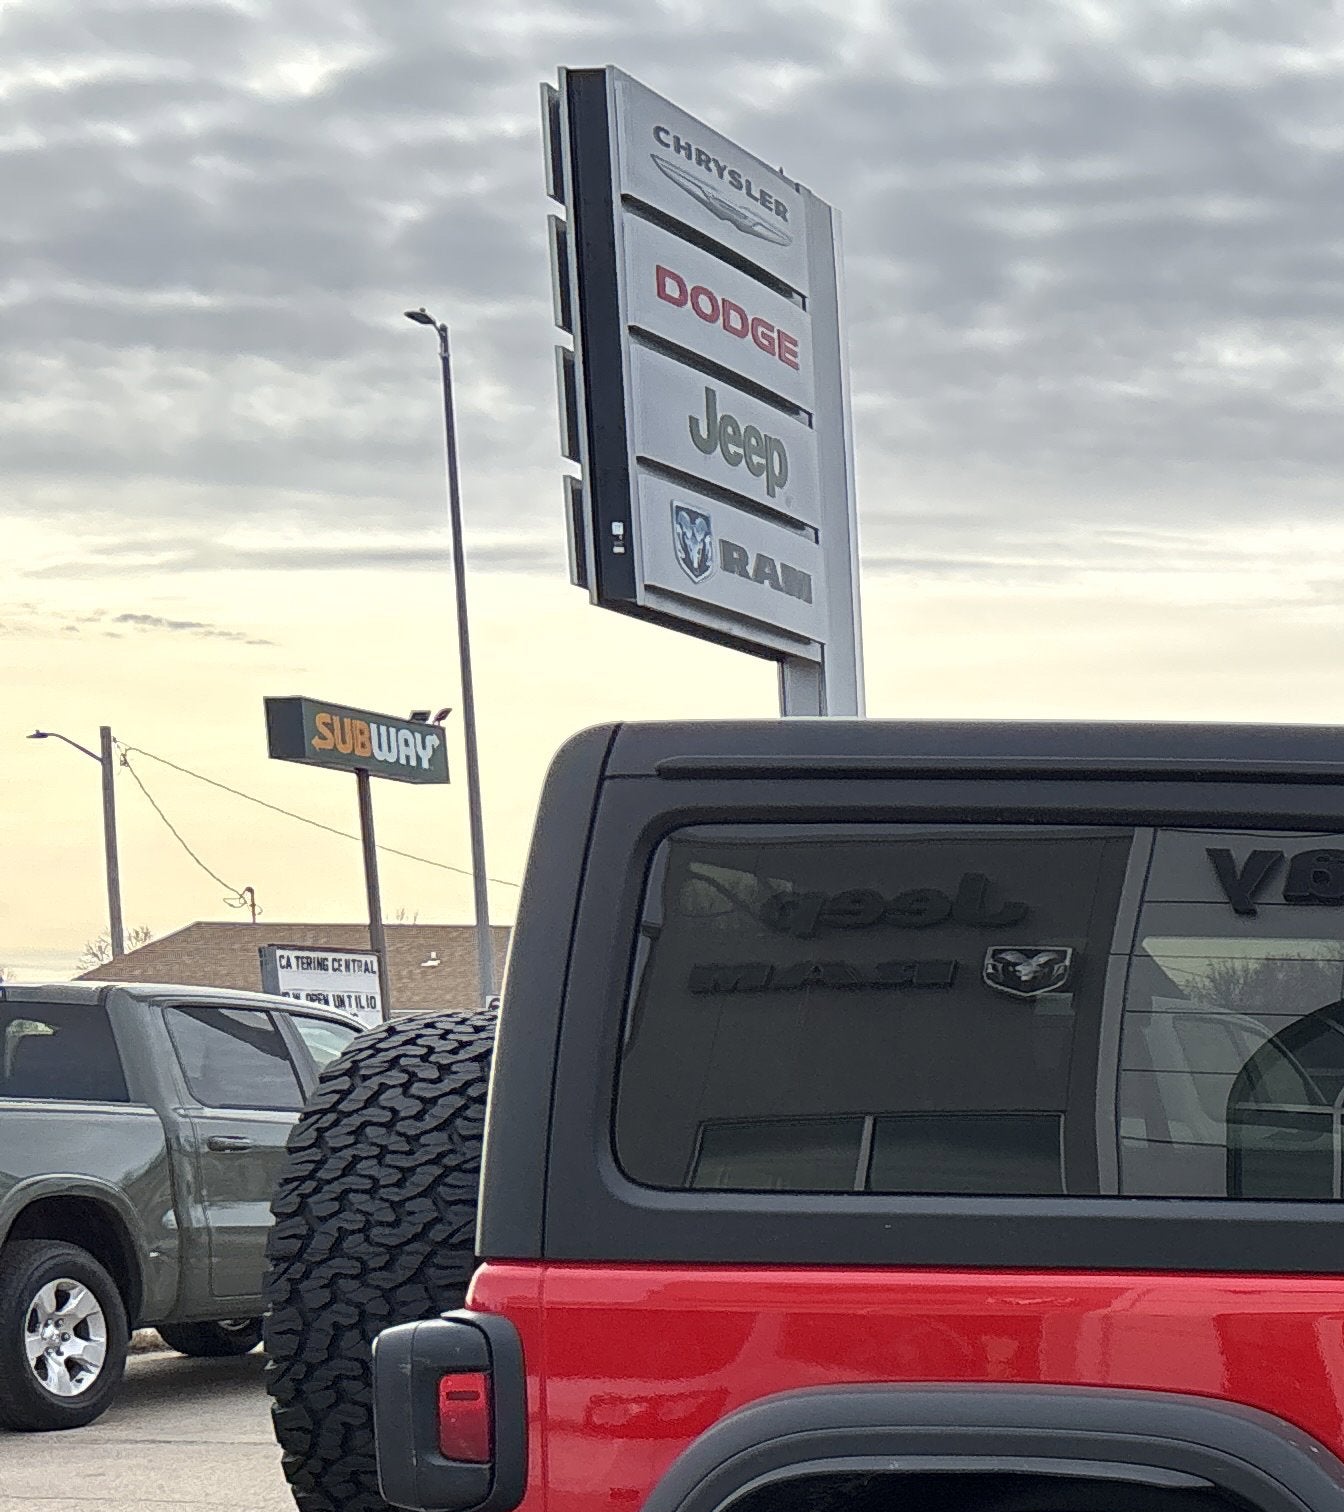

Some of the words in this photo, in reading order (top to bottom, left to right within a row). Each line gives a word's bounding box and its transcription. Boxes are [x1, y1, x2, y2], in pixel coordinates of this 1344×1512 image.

[652, 125, 789, 223] CHRYSLER
[656, 264, 800, 370] DODGE
[688, 386, 789, 498] Jeep
[718, 538, 813, 605] RAM
[311, 712, 440, 770] SUBWAY
